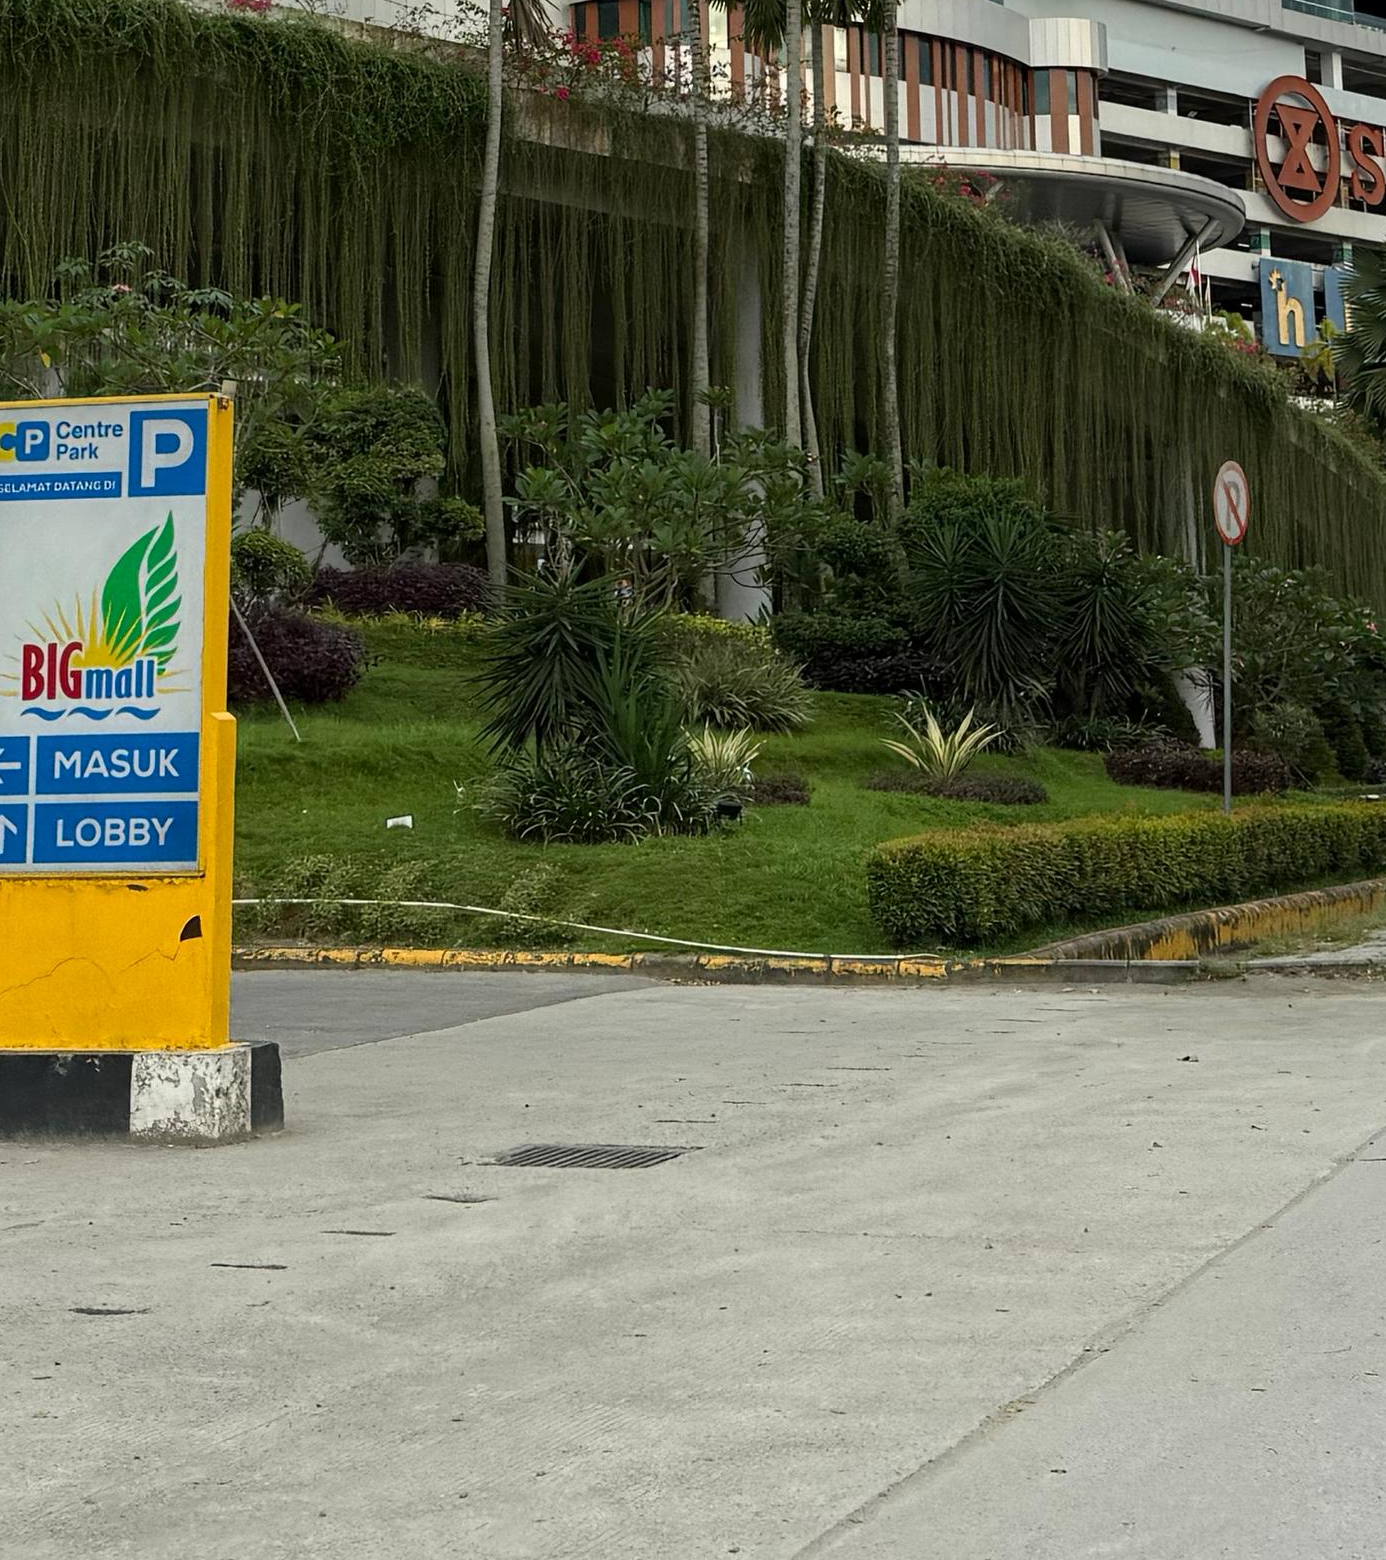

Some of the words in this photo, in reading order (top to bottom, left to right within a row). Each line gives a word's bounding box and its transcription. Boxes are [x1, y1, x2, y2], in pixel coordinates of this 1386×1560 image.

[56, 421, 124, 439] Centre
[56, 442, 99, 461] Park
[140, 418, 195, 488] P
[54, 481, 102, 492] DATANG
[104, 480, 116, 490] DI
[22, 641, 83, 701] BIG
[85, 659, 156, 700] mall
[53, 748, 180, 779] MASUK
[56, 817, 174, 848] LOBBY
